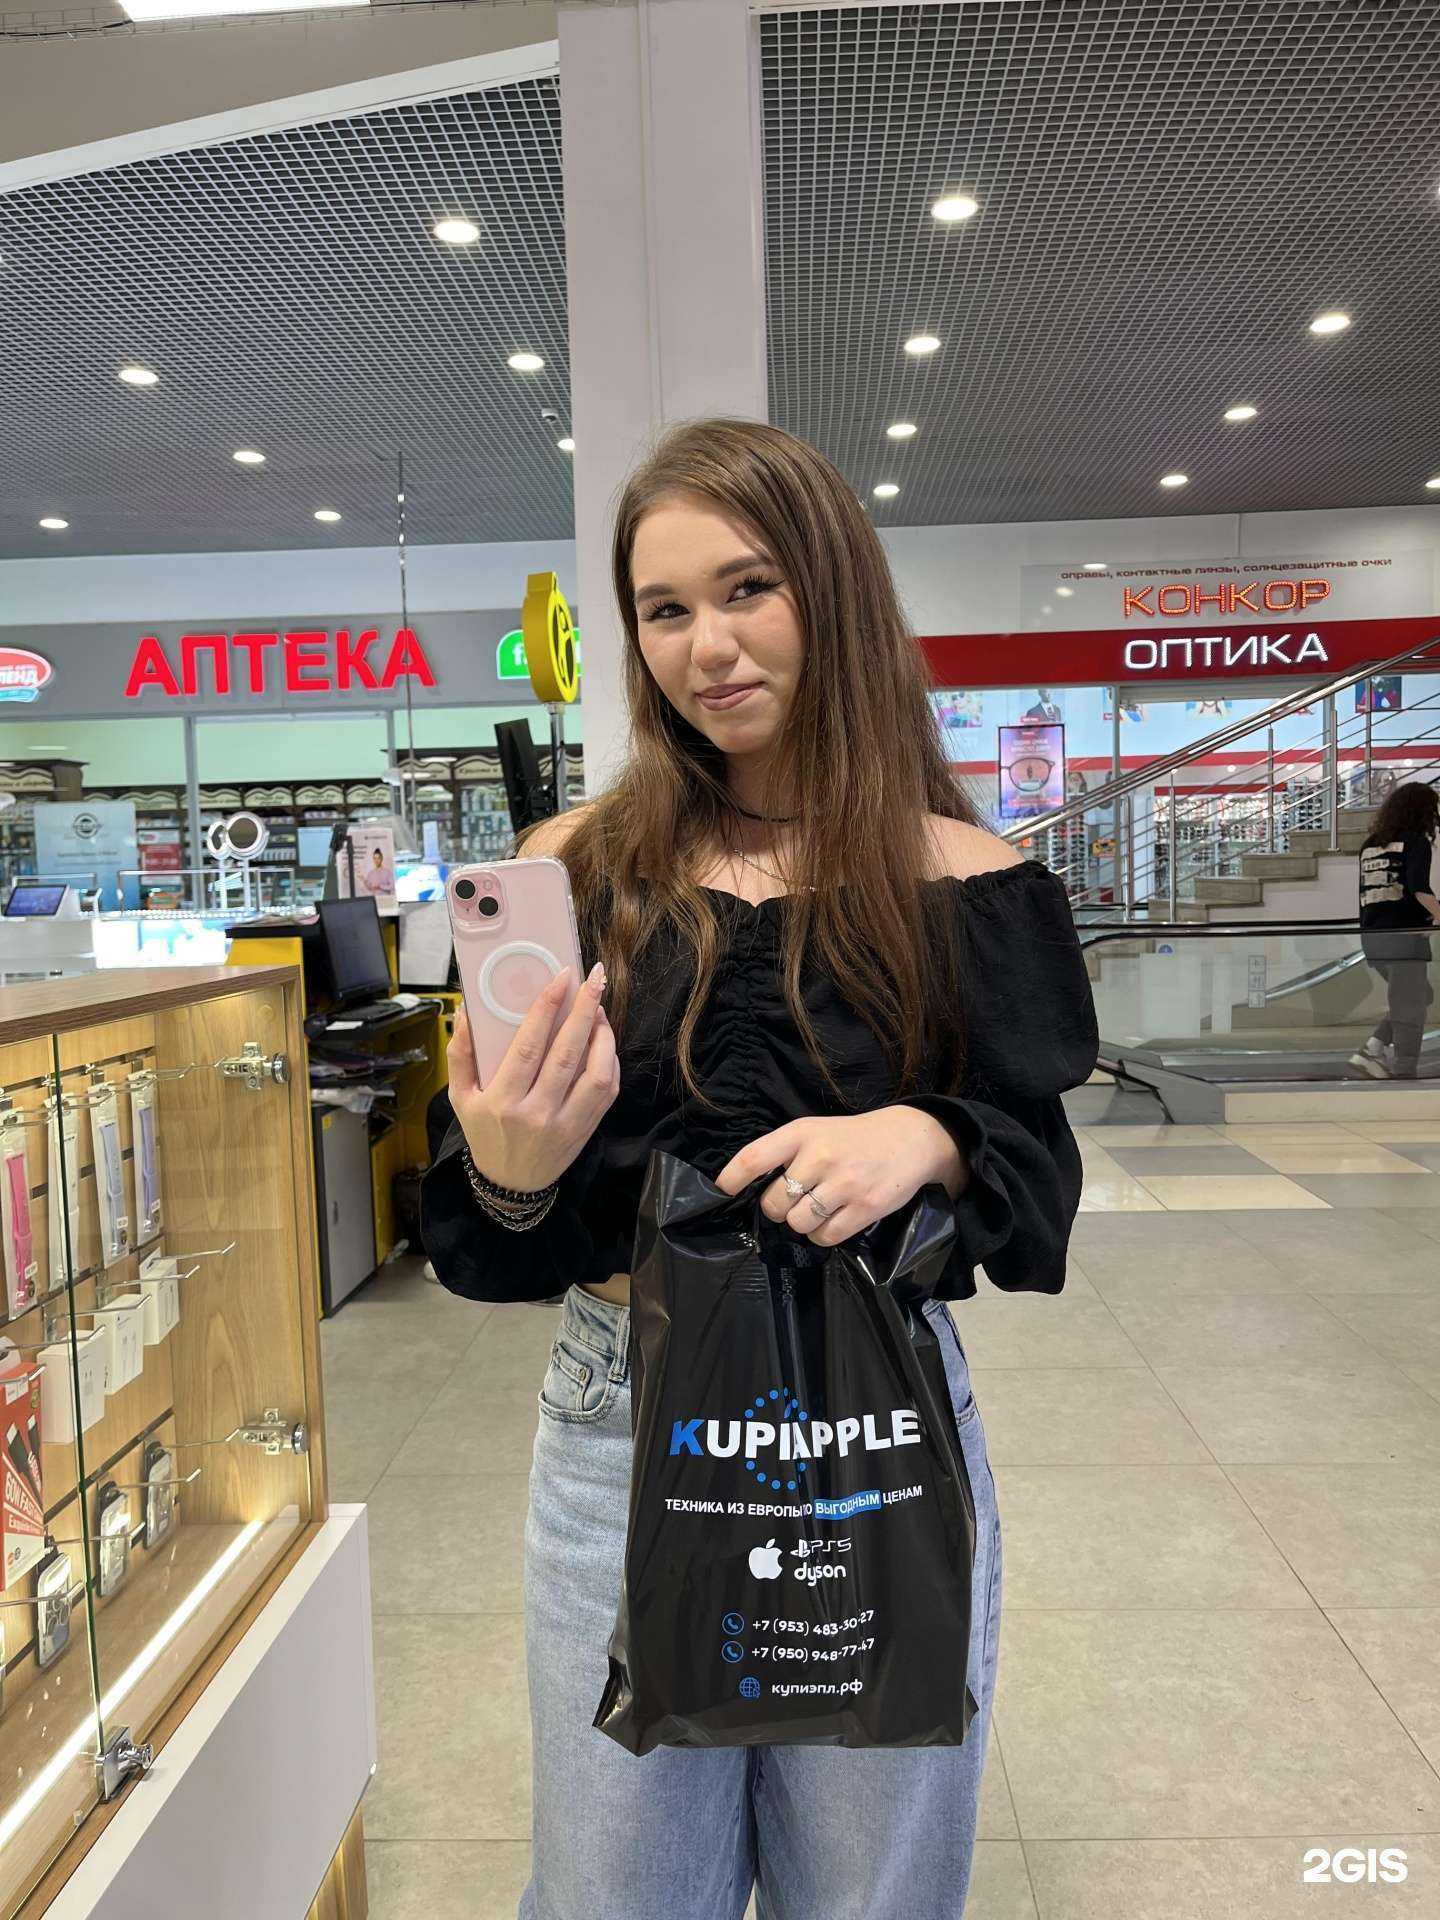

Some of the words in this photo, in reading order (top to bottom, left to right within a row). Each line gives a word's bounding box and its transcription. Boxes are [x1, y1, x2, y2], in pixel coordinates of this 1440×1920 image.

[1060, 569, 1113, 580] оправы,
[1116, 566, 1192, 577] контактные
[1243, 560, 1358, 572] солнцезащитные
[1361, 558, 1393, 567] очки
[1122, 578, 1332, 618] КОНКОР
[124, 628, 437, 698] АПТЕКА
[1124, 632, 1330, 670] ОПТИКА
[664, 1498, 724, 1514] ТЕХНИКА
[727, 1501, 745, 1514] ИЗ
[815, 1493, 881, 1516] ВЫГОДНЫМ
[883, 1485, 923, 1505] ЦЕНАМ
[793, 1561, 846, 1587] dyson
[752, 1618, 770, 1631] +7
[772, 1617, 809, 1635] (953)
[812, 1610, 875, 1636] 483-30-27
[751, 1646, 769, 1659] +7
[772, 1645, 808, 1663] (950)
[812, 1638, 876, 1663] 948-77-47
[771, 1678, 864, 1697] купиэпл.рф
